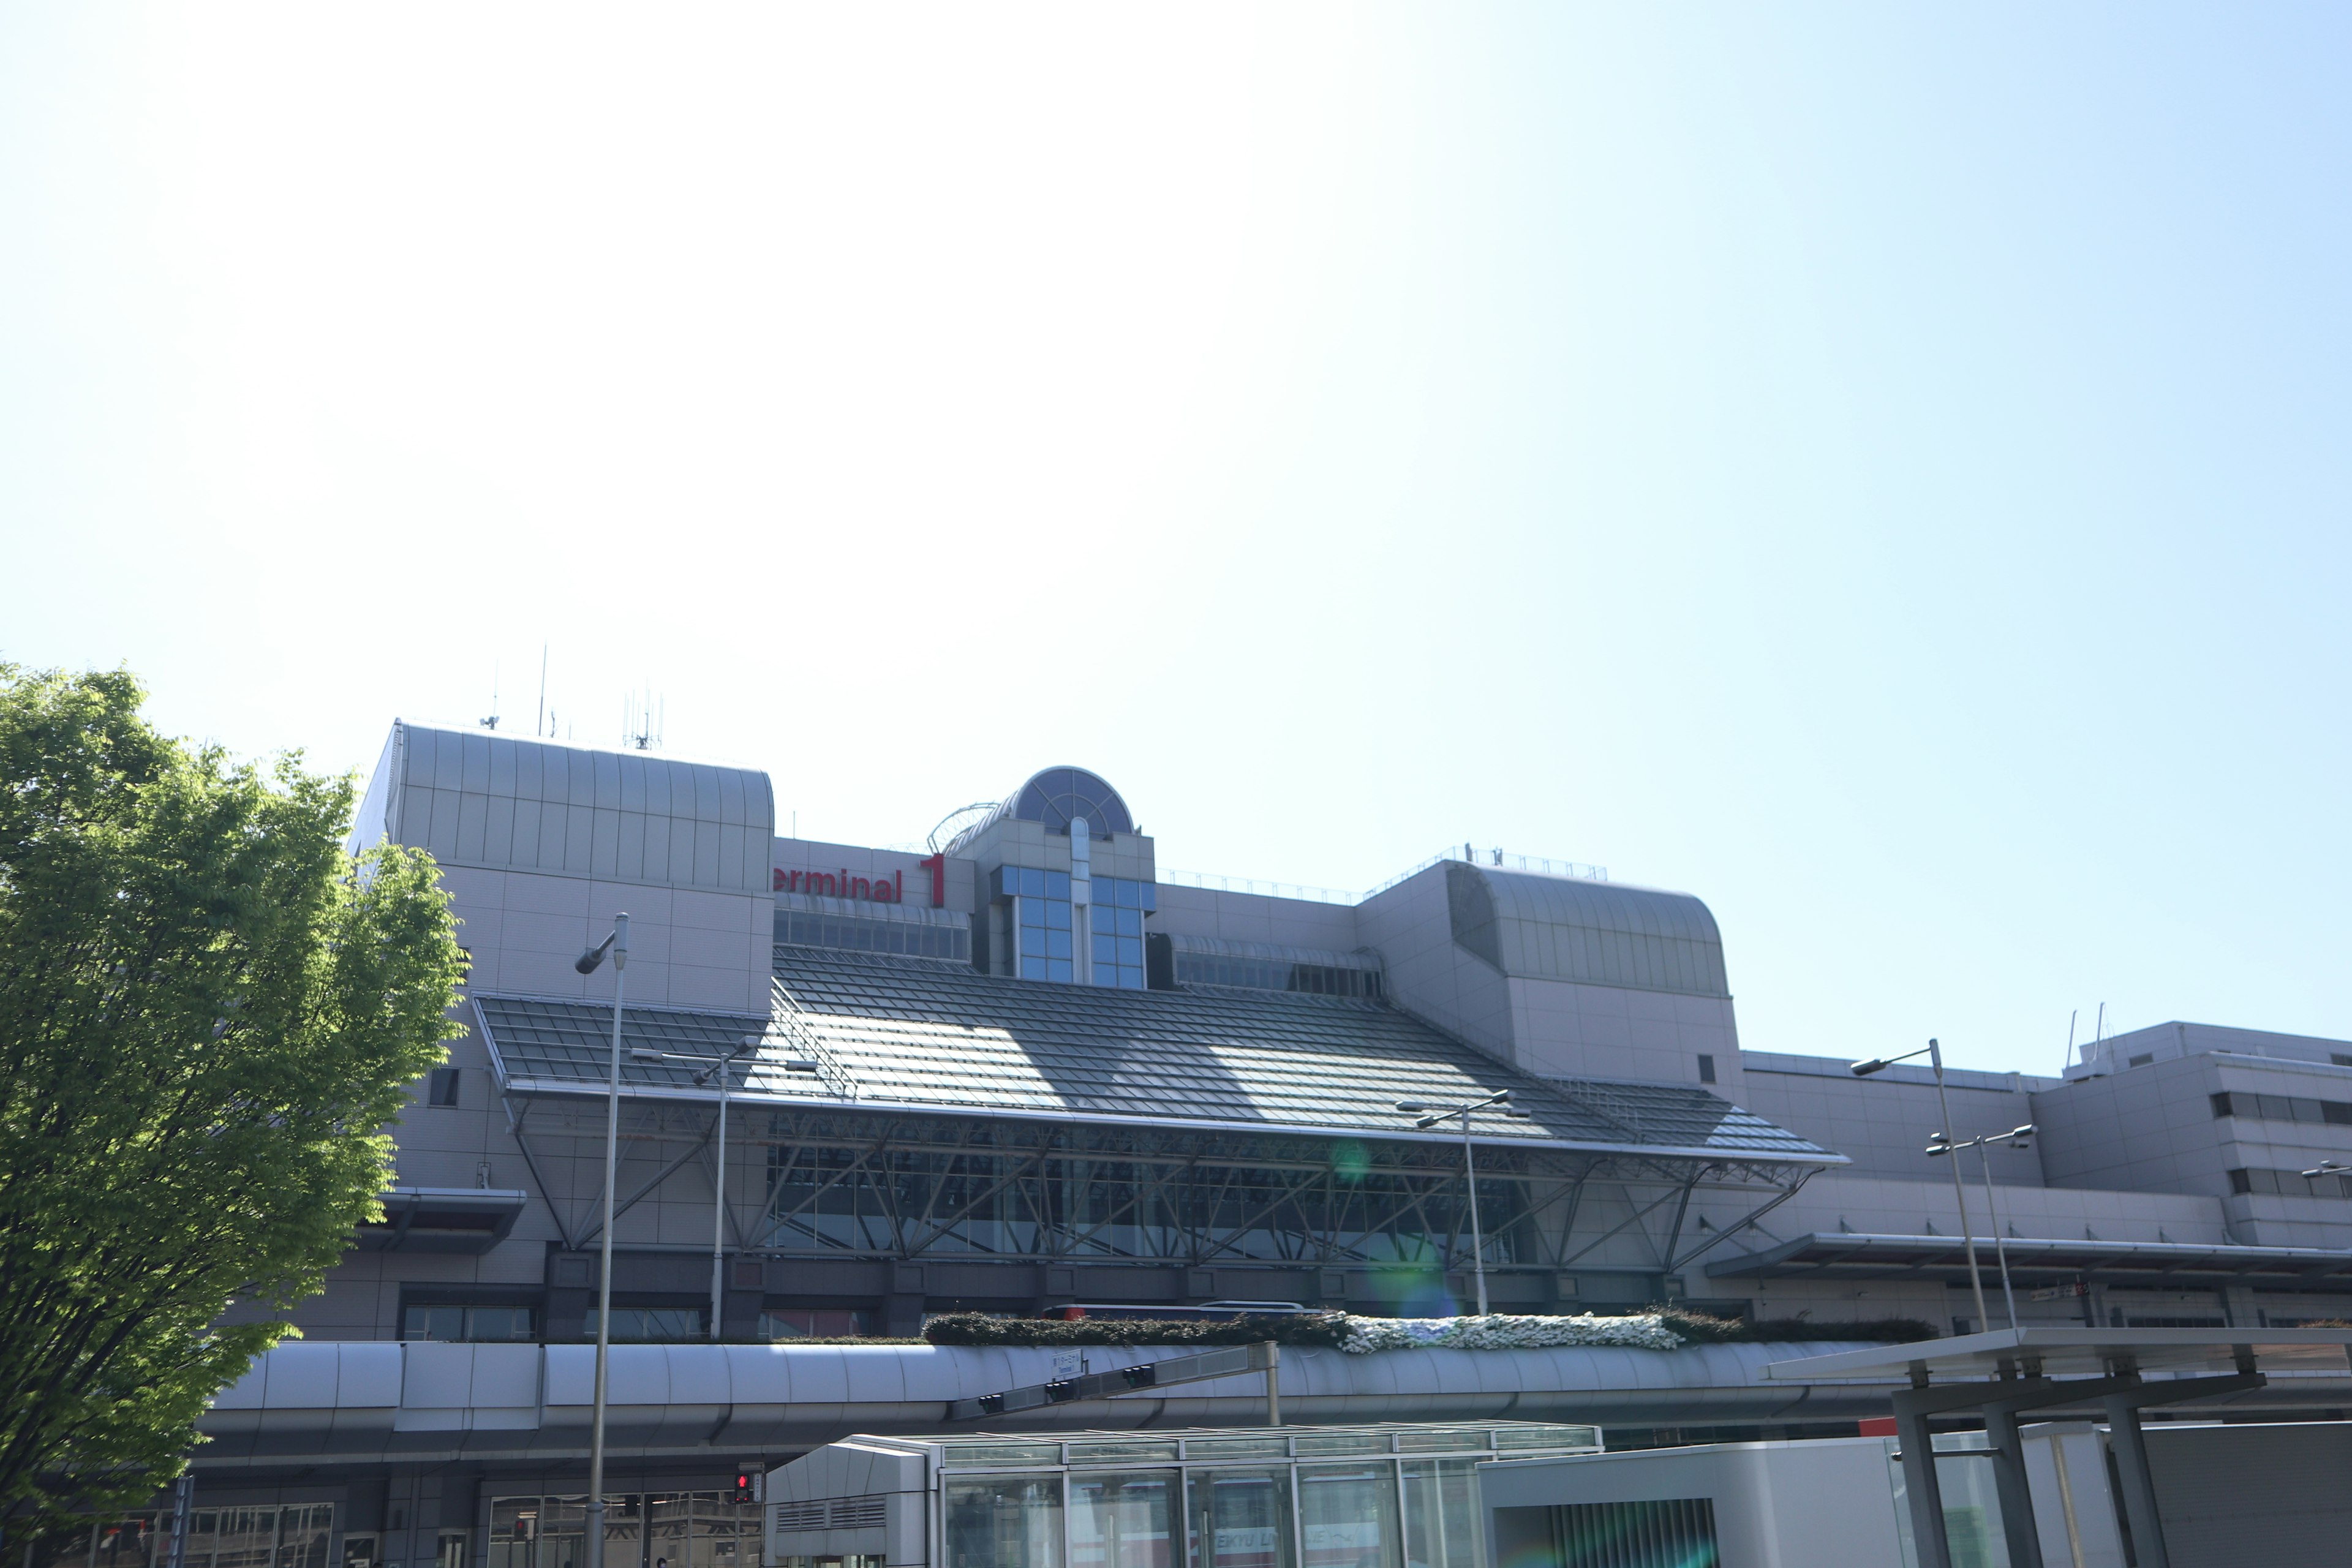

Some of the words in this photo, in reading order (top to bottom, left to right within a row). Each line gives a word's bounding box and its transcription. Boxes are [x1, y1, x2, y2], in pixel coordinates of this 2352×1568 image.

[774, 867, 902, 903] erminal
[919, 853, 944, 907] 1
[1215, 1534, 1254, 1548] EIKYU
